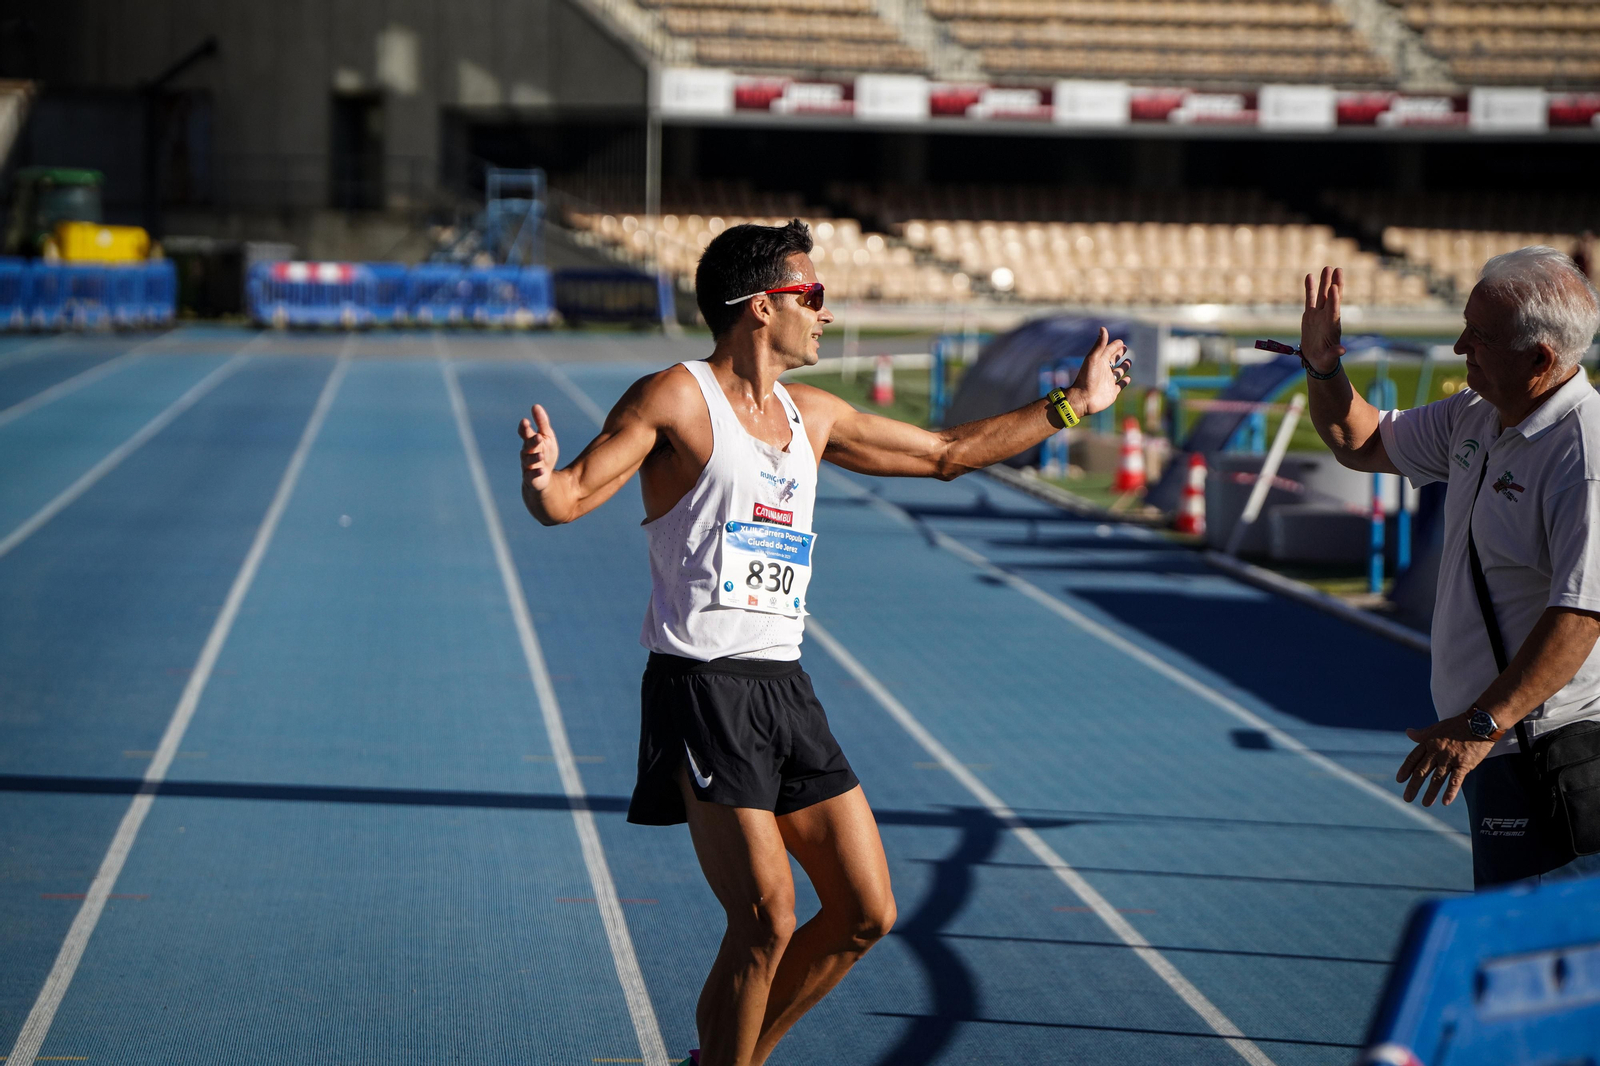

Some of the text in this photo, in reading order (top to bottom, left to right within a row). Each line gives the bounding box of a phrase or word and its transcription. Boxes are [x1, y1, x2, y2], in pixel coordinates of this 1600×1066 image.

[758, 528, 785, 539] Carrera
[747, 538, 798, 553] Ciudad de Jerez
[746, 560, 794, 595] 830
[1481, 817, 1529, 830] RFEA
